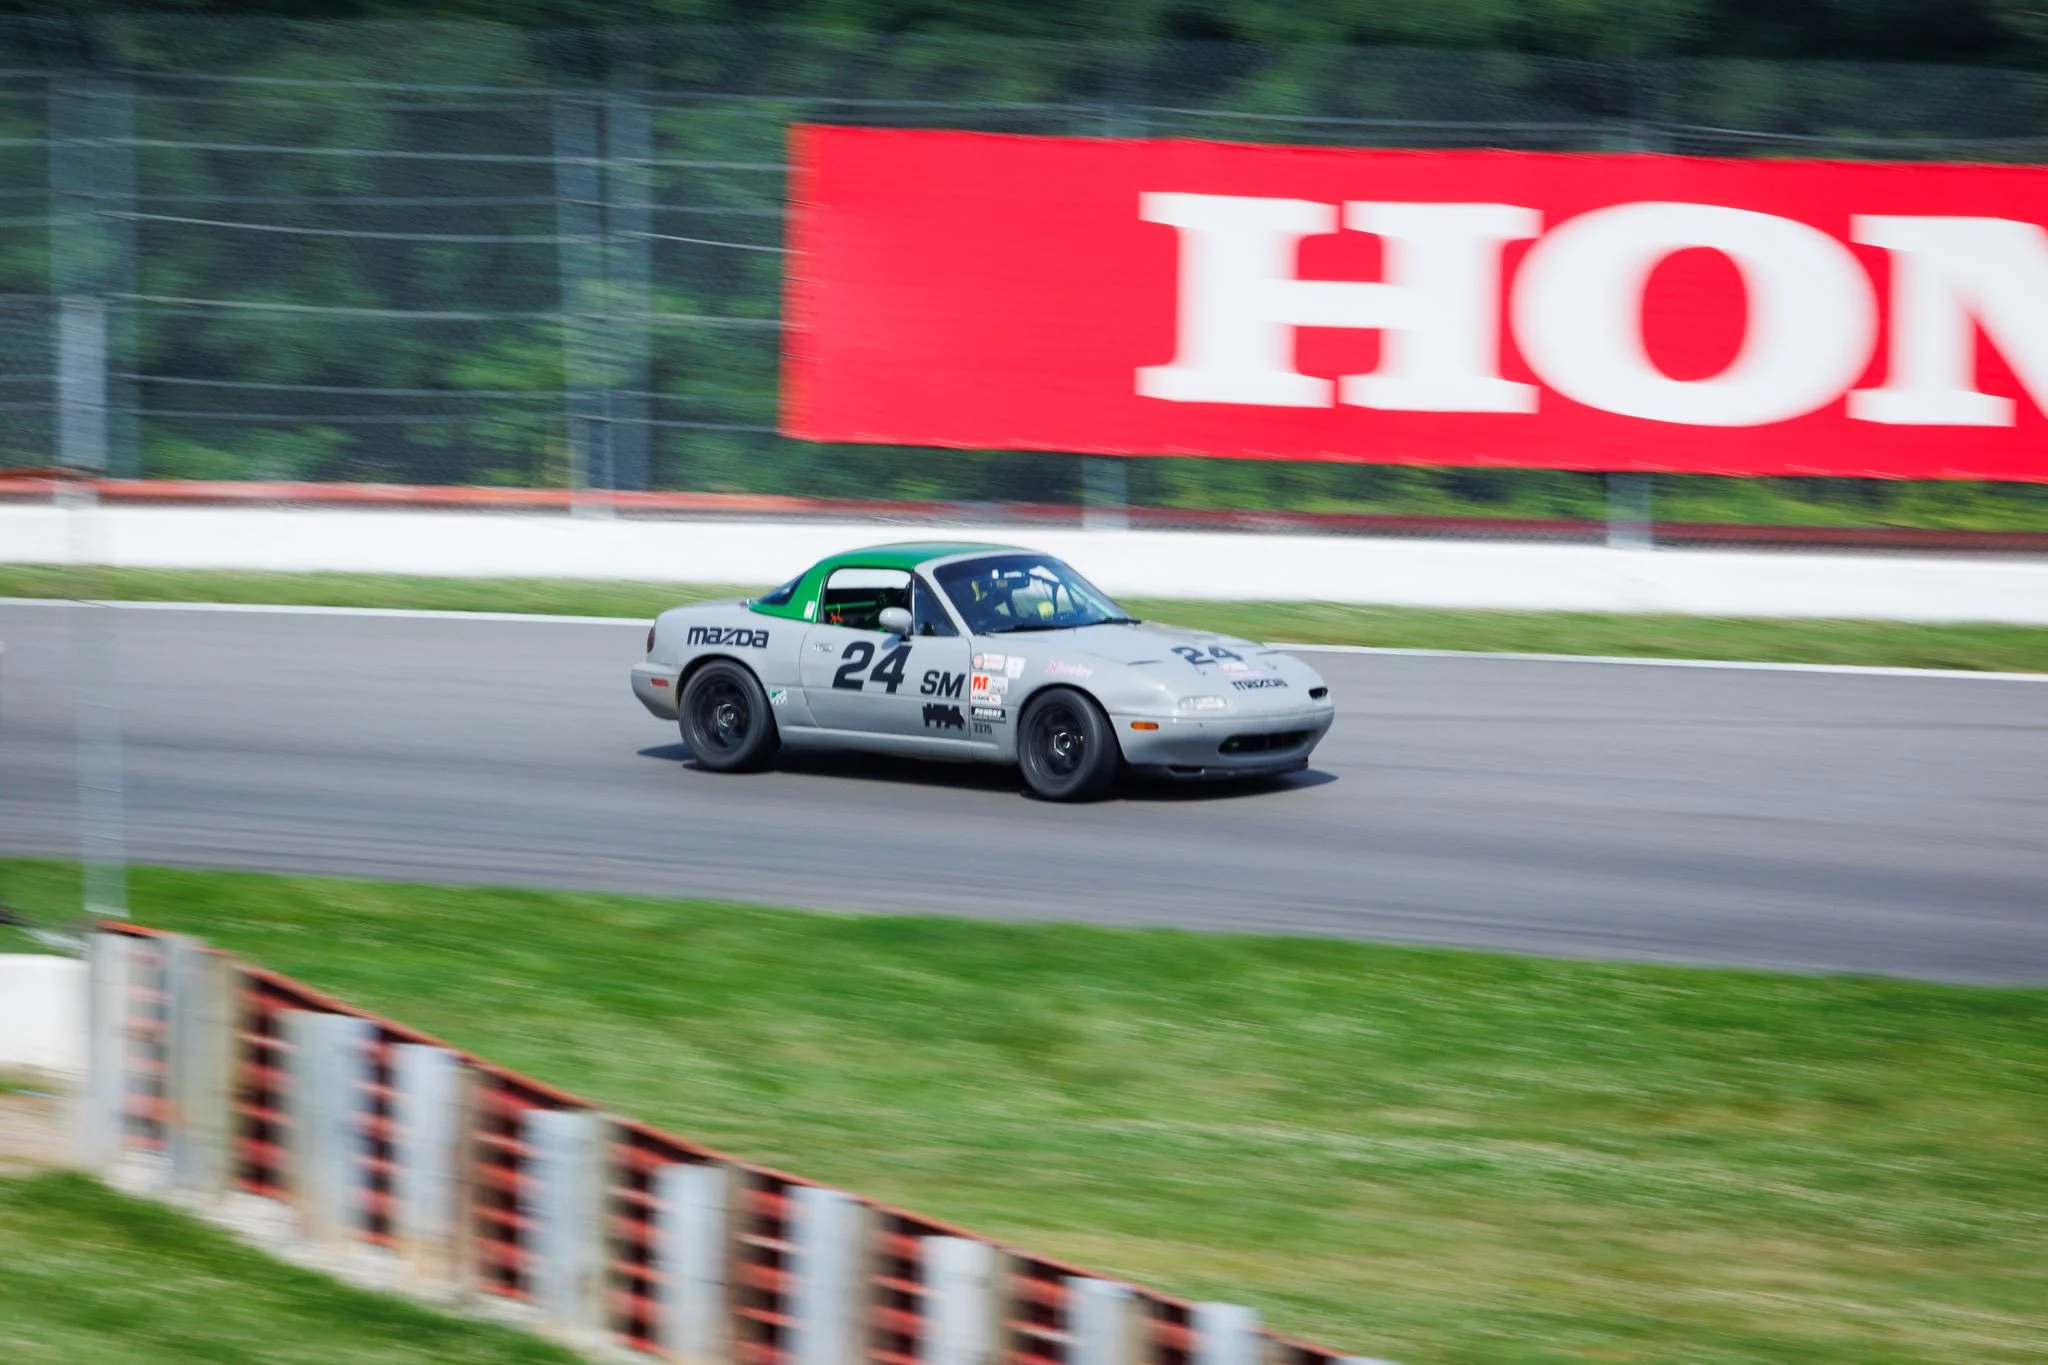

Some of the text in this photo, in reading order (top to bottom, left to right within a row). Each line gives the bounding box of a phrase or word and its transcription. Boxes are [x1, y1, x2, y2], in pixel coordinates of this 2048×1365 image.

[832, 641, 913, 694] 24
[1171, 645, 1244, 665] 24
[920, 670, 966, 698] SM
